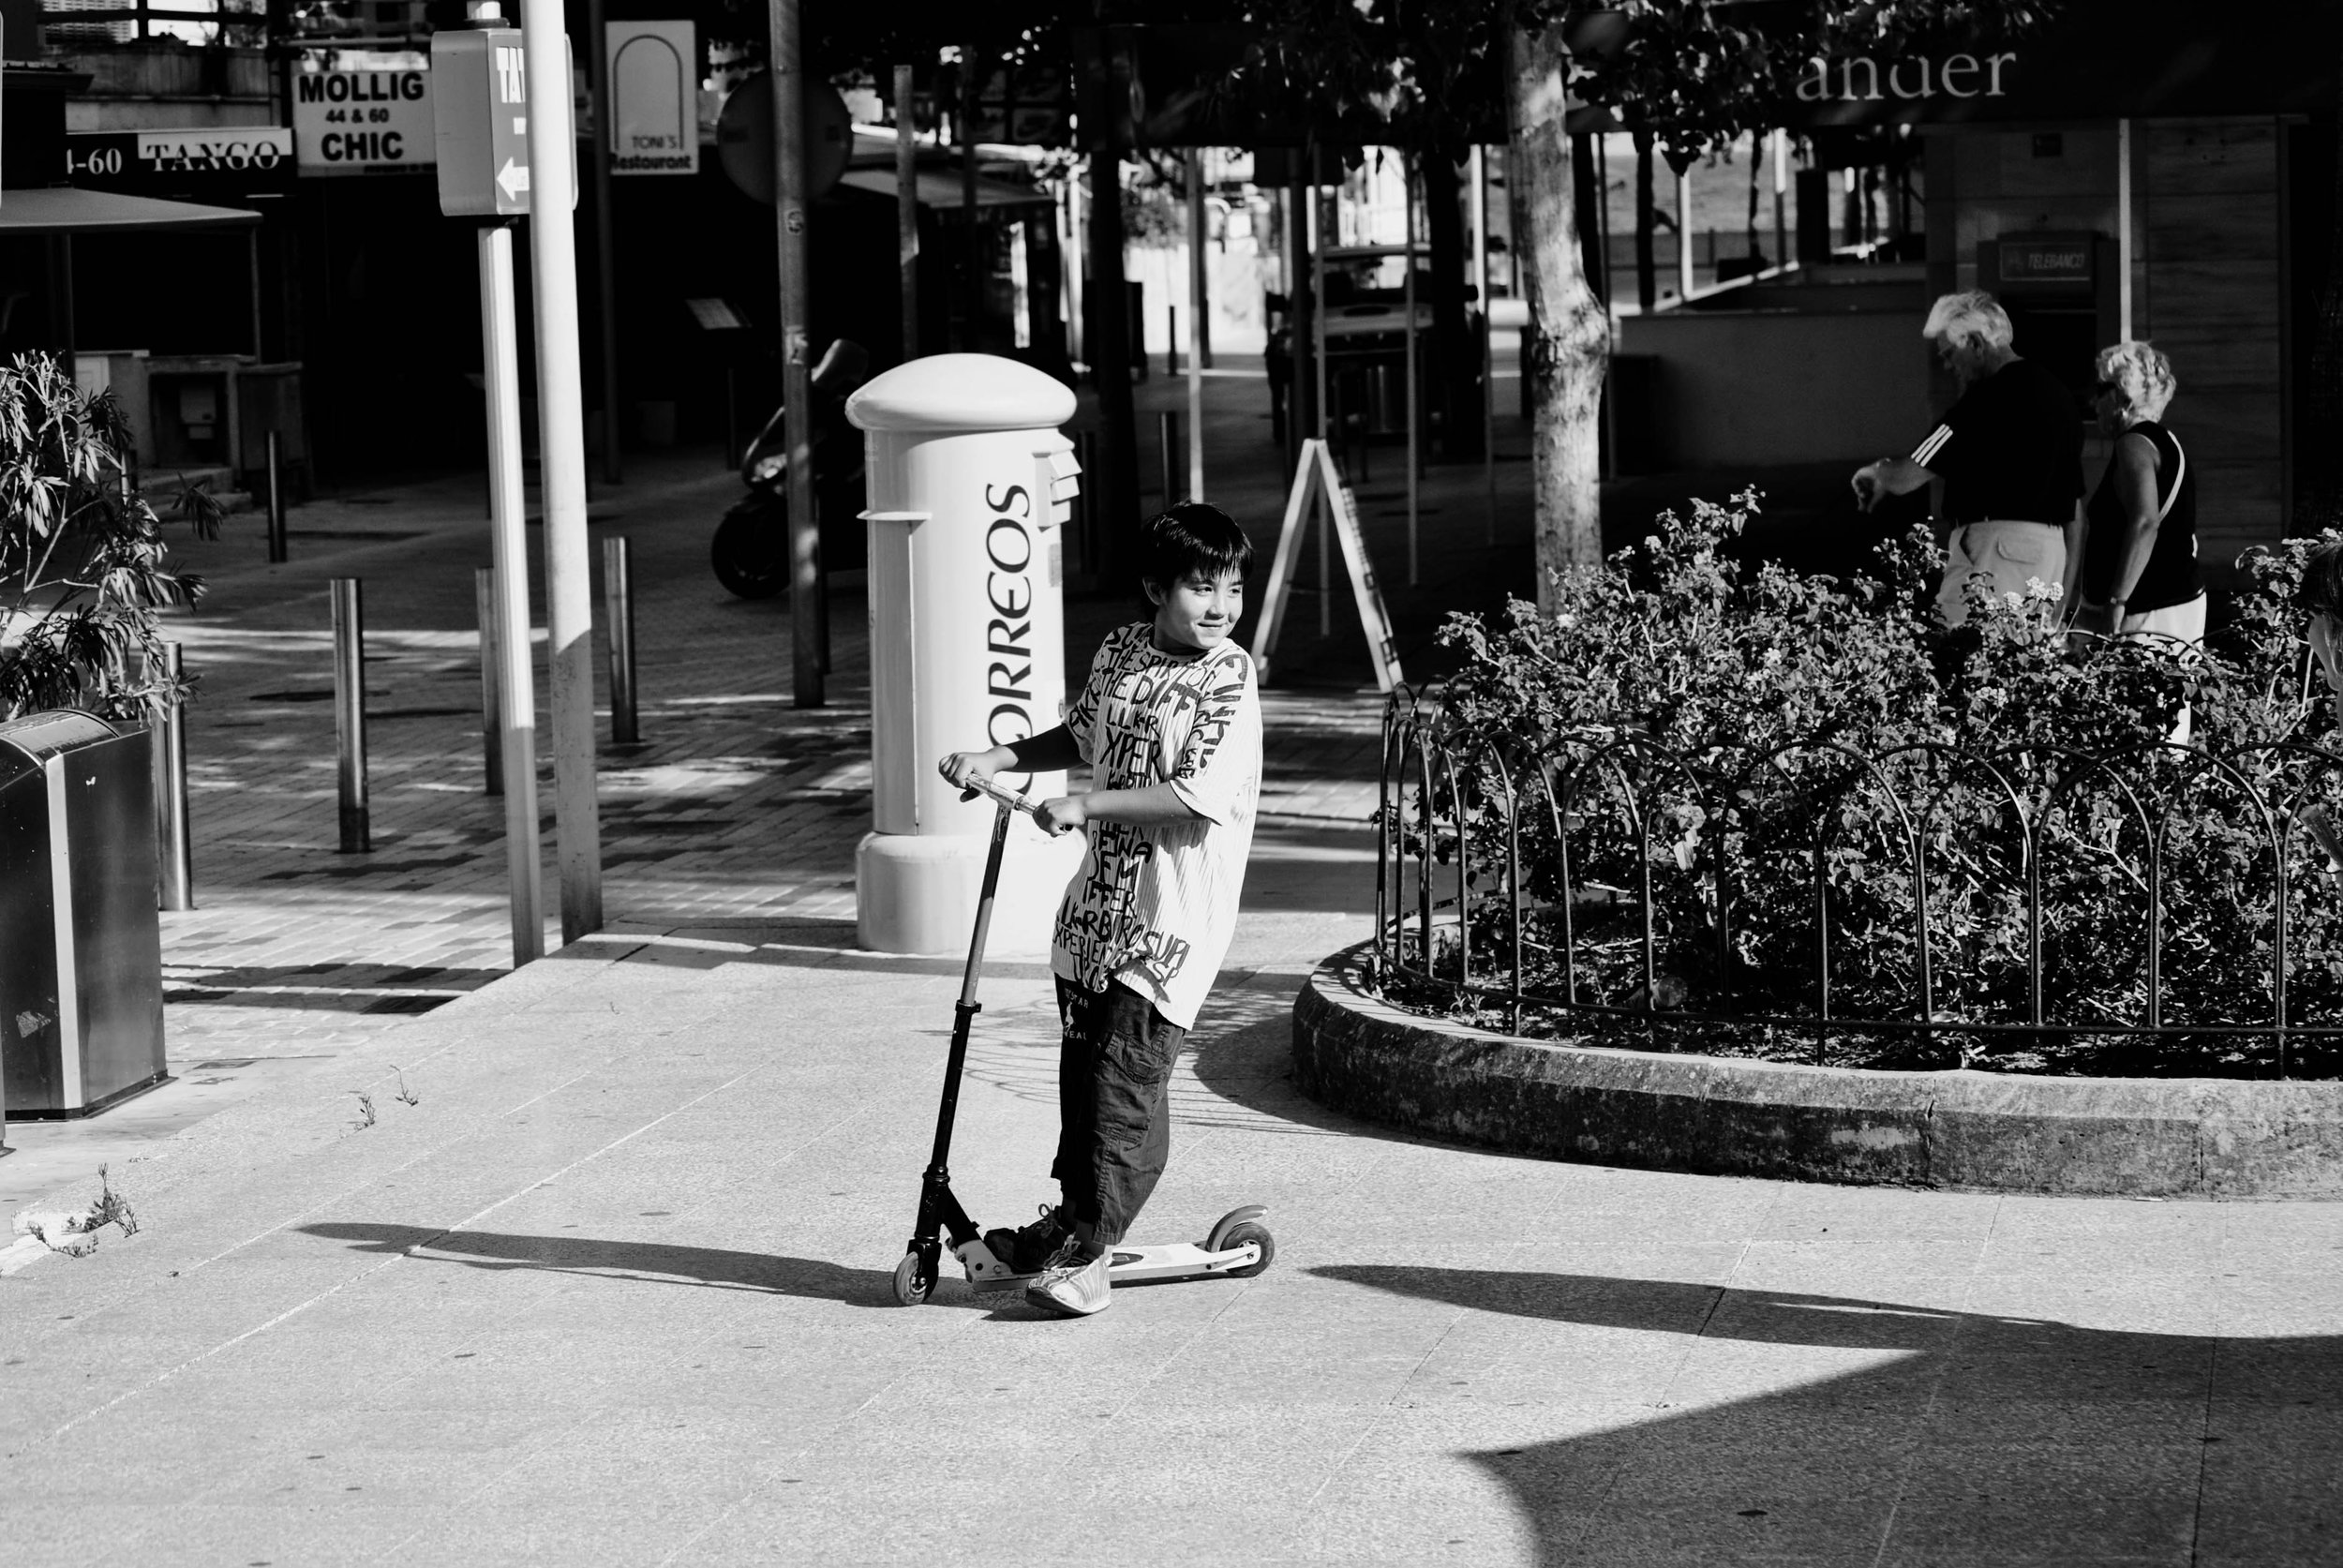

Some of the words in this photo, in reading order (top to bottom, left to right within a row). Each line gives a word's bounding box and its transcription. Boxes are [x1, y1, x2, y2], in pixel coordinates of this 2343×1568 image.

[299, 72, 424, 102] MOLLIG
[325, 109, 346, 123] 44
[351, 109, 363, 123] &
[369, 108, 389, 123] 60
[146, 142, 280, 172] TANGO
[321, 132, 403, 160] CHIC
[2027, 253, 2086, 271] TELEBANCO
[986, 484, 1034, 796] ORREOS
